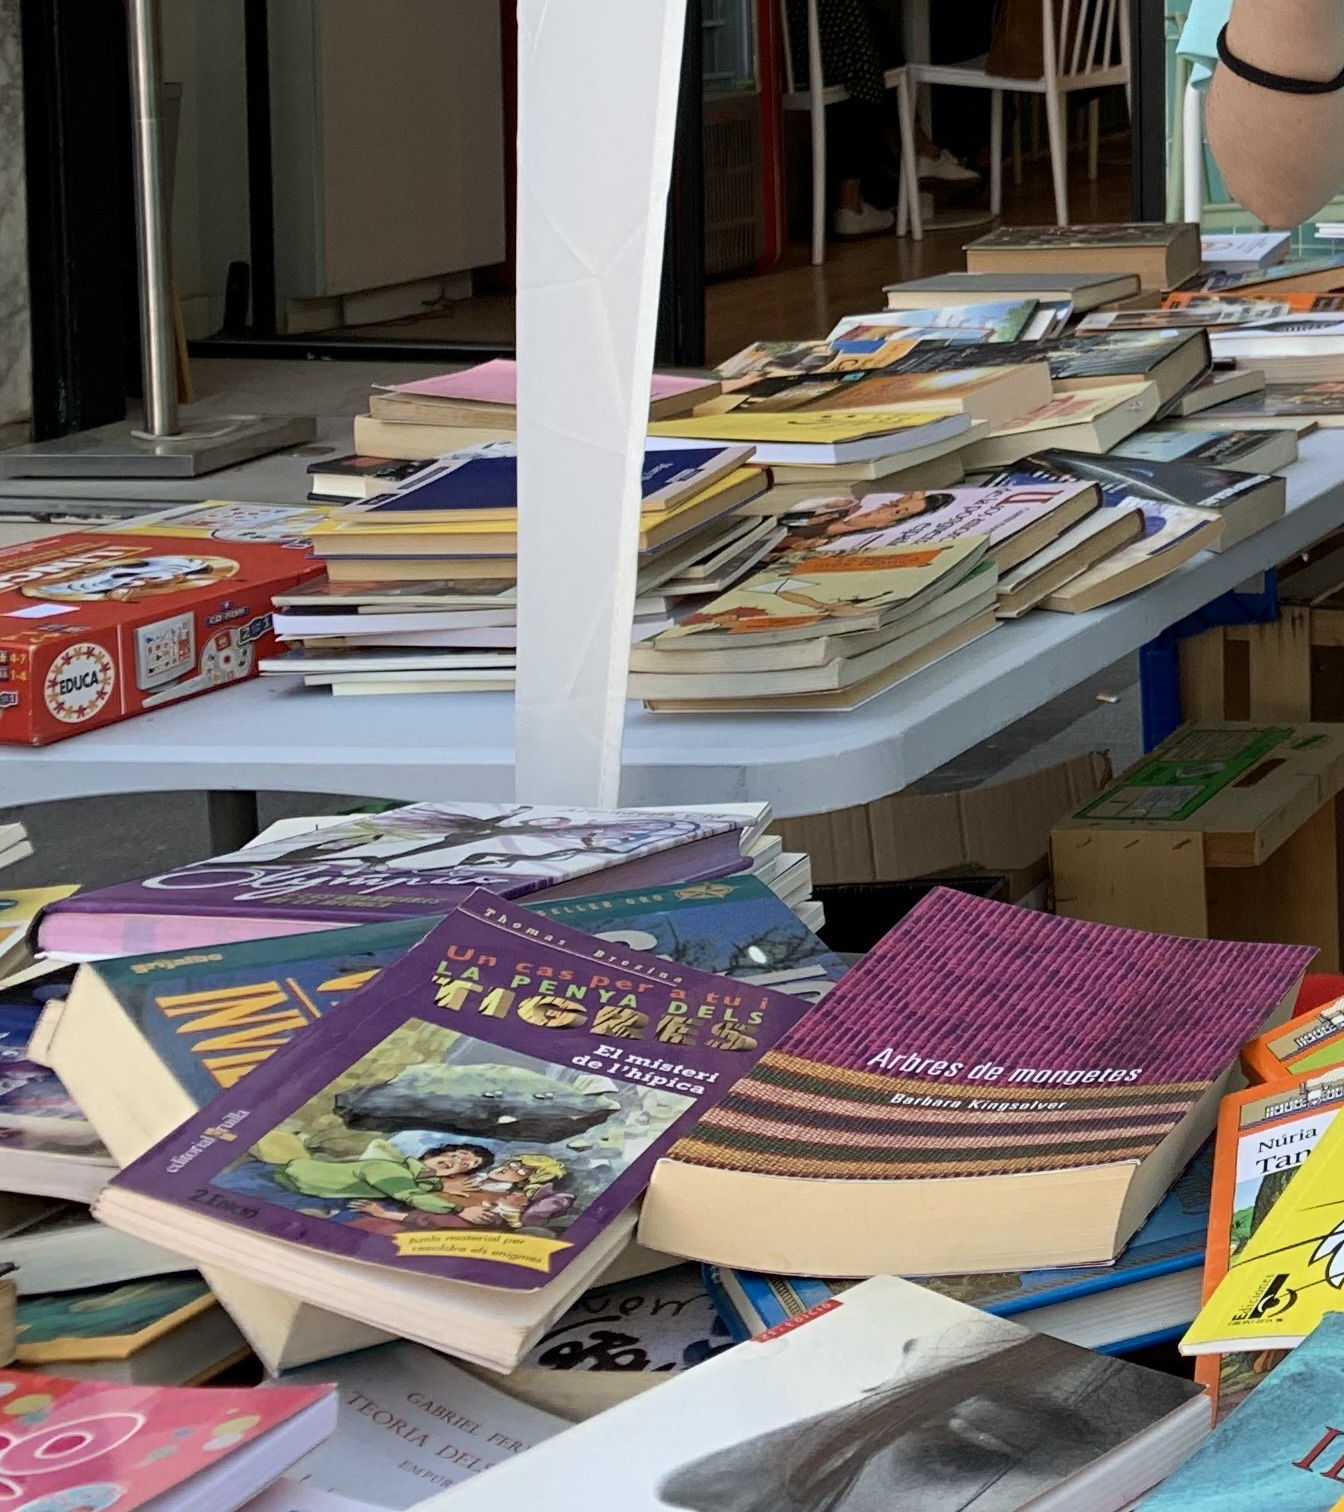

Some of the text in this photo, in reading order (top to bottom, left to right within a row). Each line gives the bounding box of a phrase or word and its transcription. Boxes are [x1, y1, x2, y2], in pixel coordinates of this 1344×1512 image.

[58, 669, 100, 696] EDUCA
[485, 907, 684, 984] Thomas Brezina
[435, 960, 765, 1026] LA PENYA DELS
[446, 944, 770, 1011] Un cas per a tu i
[430, 975, 759, 1052] TIGRES
[571, 1052, 603, 1070] de
[592, 1044, 720, 1085] El misteri
[867, 1047, 1144, 1087] Arbres de mongetes
[890, 1092, 1068, 1113] Barbara Kingsolver
[1258, 1126, 1318, 1154] Núria
[346, 1391, 430, 1448] TEORIA
[406, 1392, 483, 1437] GABRIEL
